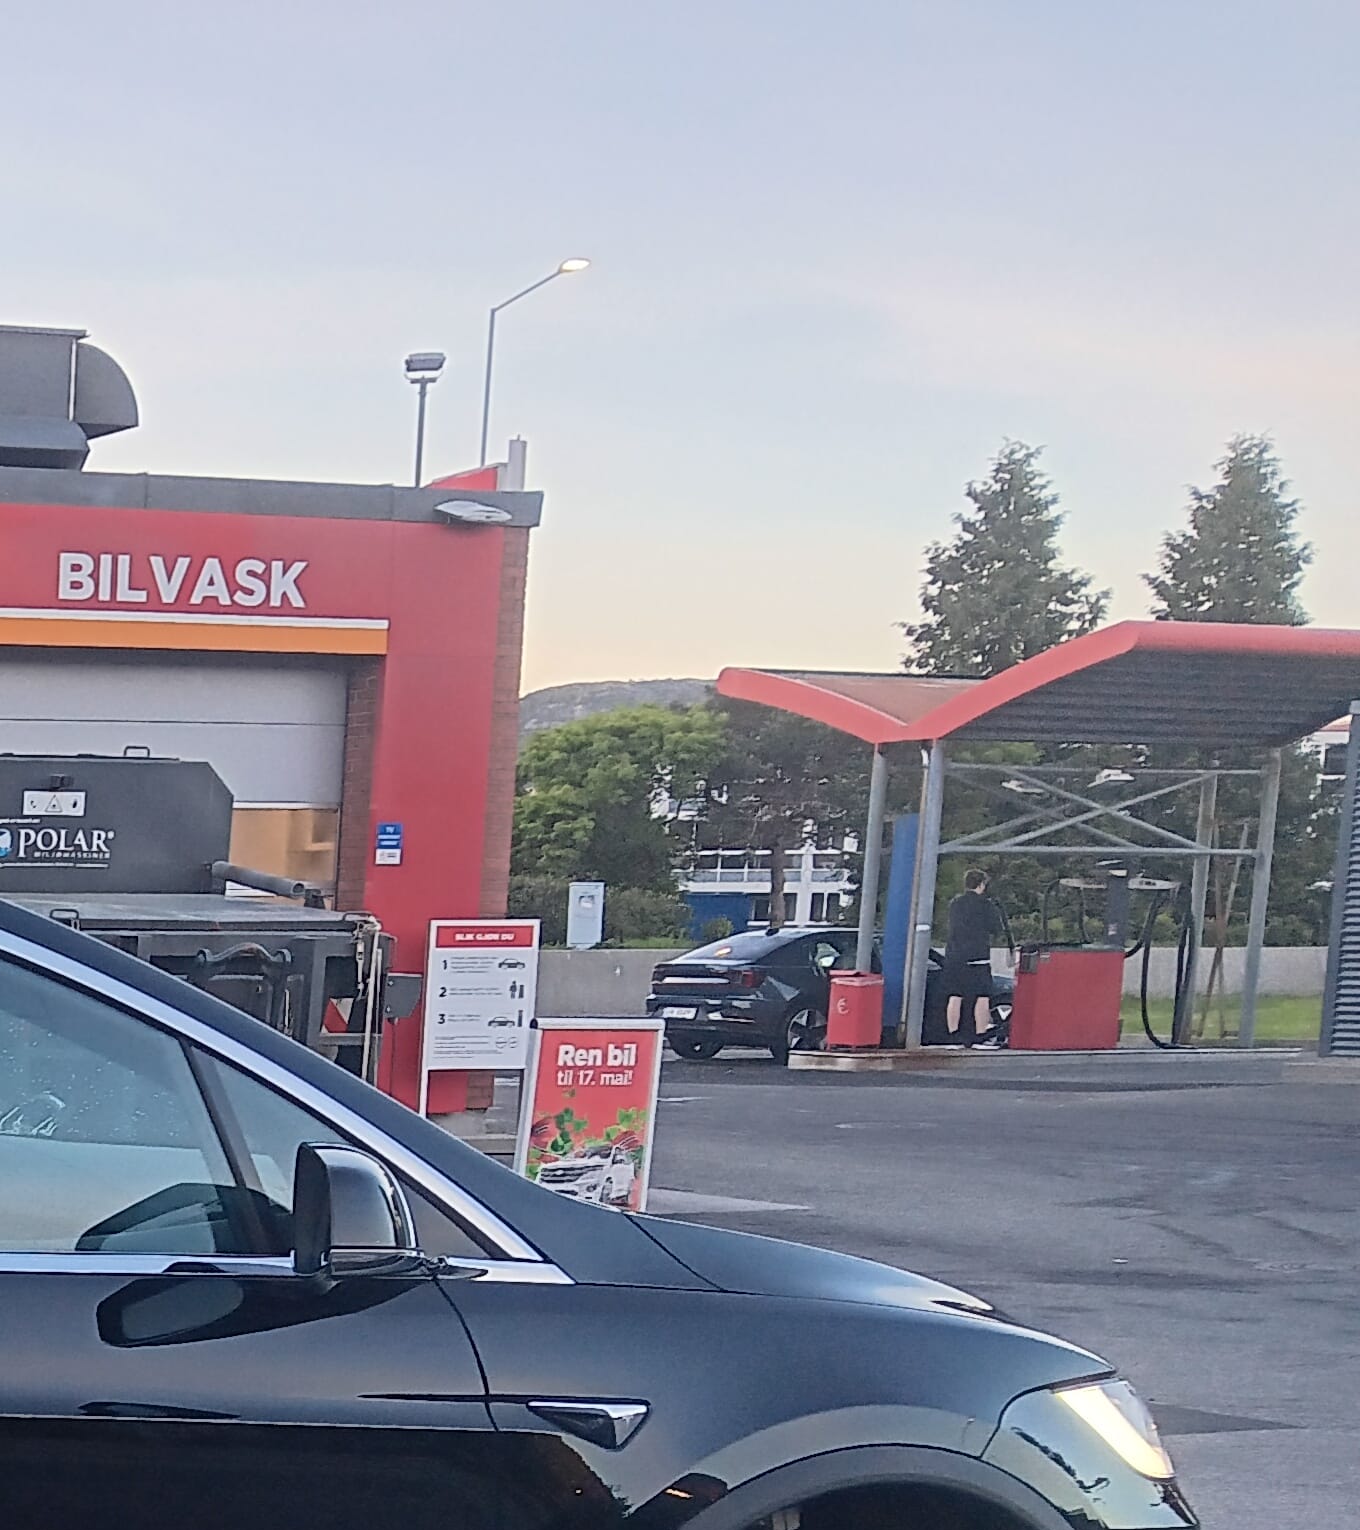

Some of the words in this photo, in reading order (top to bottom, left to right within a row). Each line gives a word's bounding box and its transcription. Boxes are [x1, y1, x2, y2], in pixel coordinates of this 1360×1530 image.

[58, 552, 309, 608] BILVASK
[17, 828, 111, 858] POLAR
[442, 960, 448, 970] 1
[439, 987, 447, 998] 2
[438, 1014, 446, 1024] 3
[557, 1044, 602, 1067] Ren
[607, 1044, 637, 1067] bil
[557, 1070, 573, 1085] til
[578, 1070, 596, 1086] 17.
[600, 1070, 633, 1085] mai!
